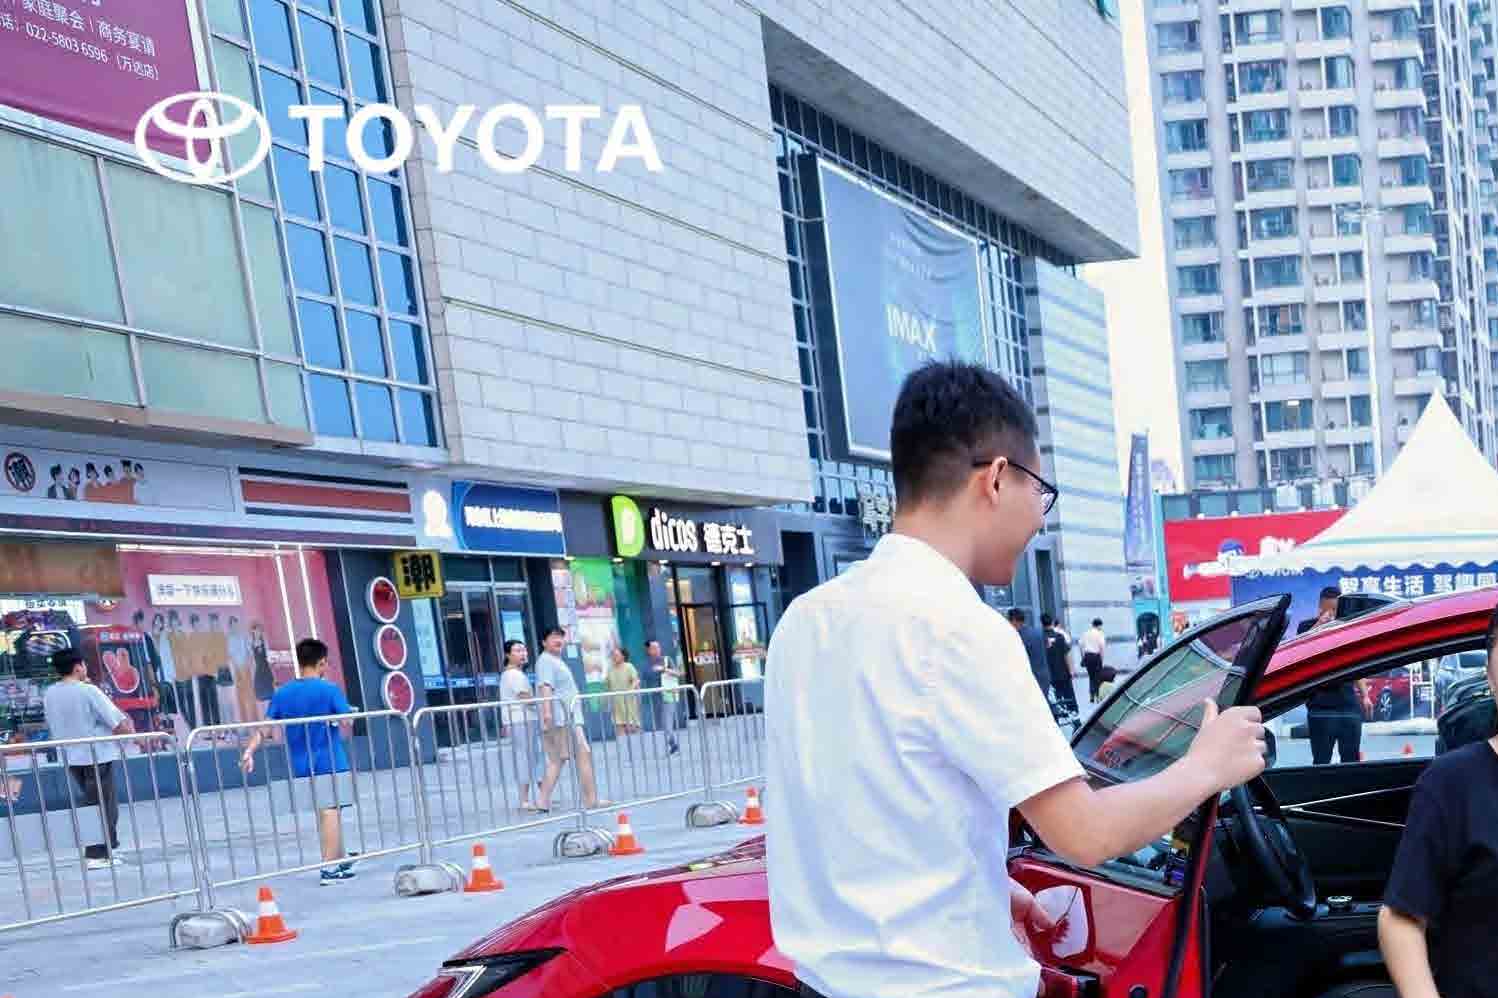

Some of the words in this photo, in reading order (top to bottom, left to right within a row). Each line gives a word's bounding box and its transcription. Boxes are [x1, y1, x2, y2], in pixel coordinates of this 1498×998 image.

[887, 304, 936, 352] IMAX
[650, 507, 698, 553] dicos
[703, 522, 754, 555] 德克士
[402, 555, 437, 594] 潮
